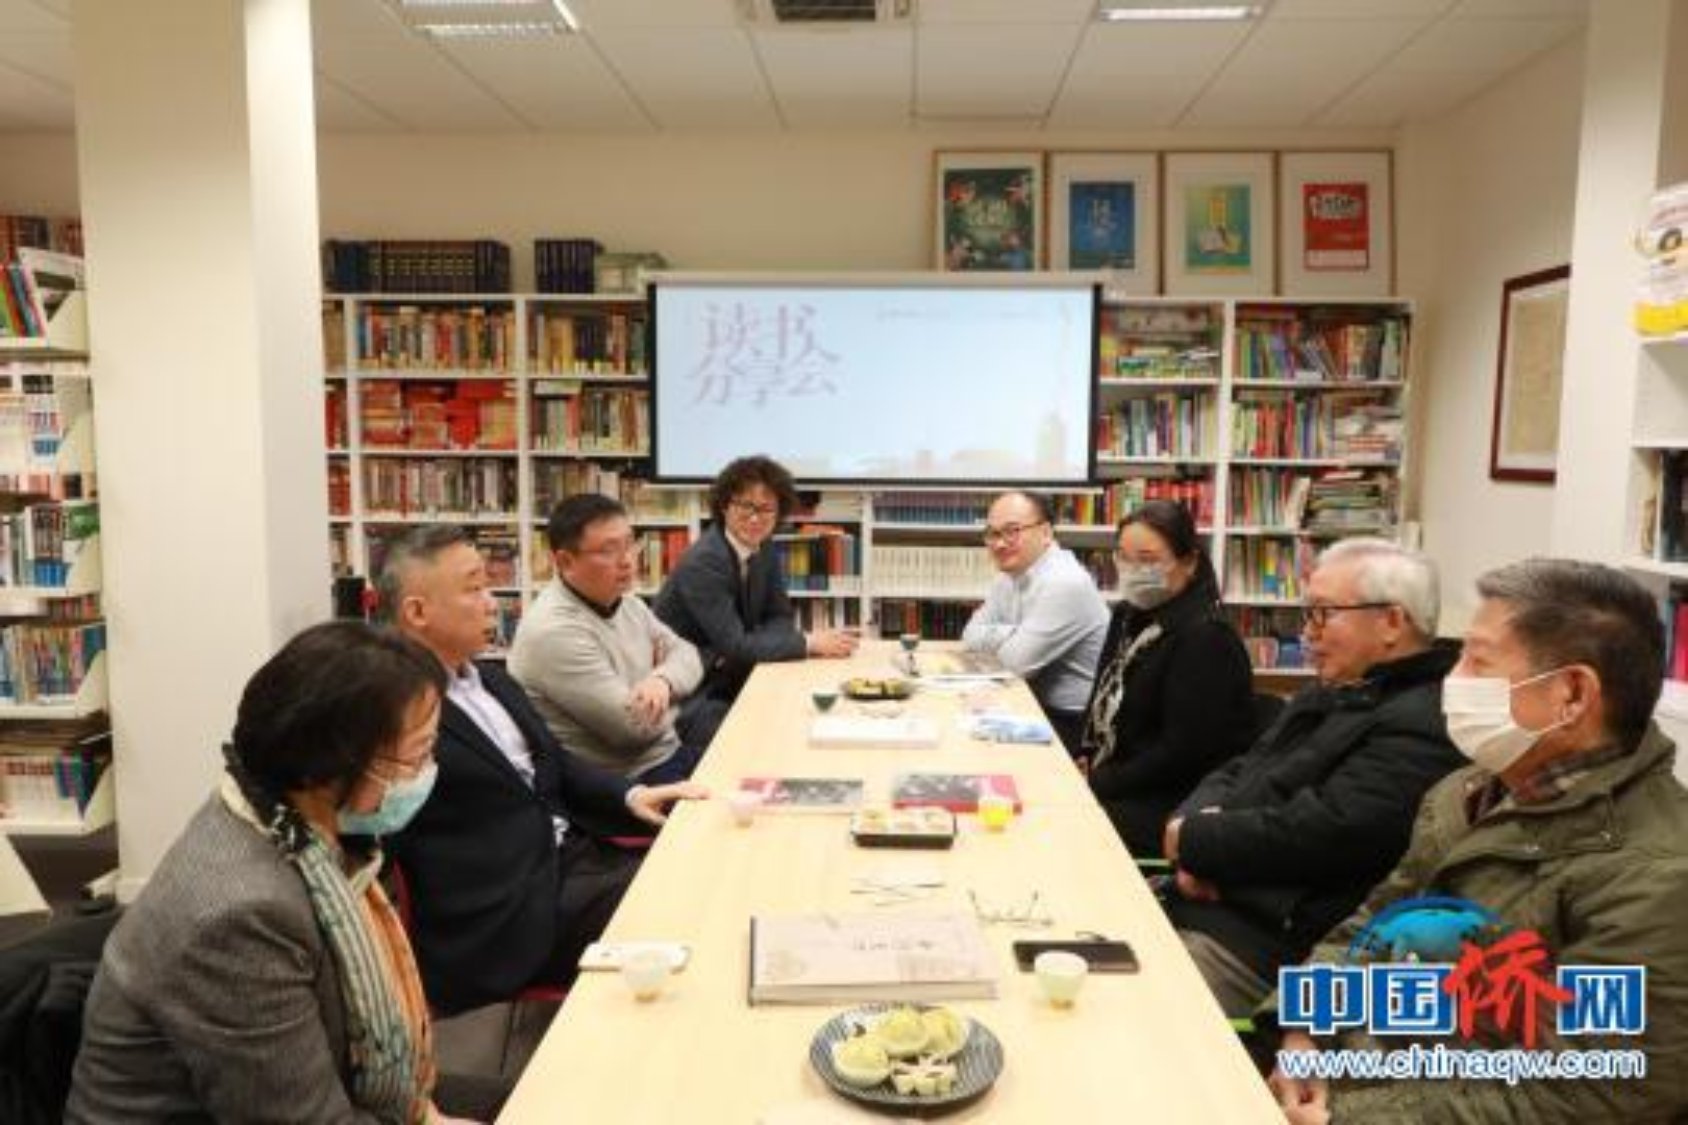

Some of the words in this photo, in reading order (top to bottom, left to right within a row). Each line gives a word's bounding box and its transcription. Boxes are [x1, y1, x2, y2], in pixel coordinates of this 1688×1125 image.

[699, 301, 820, 359] 读书
[683, 345, 842, 408] 分享会
